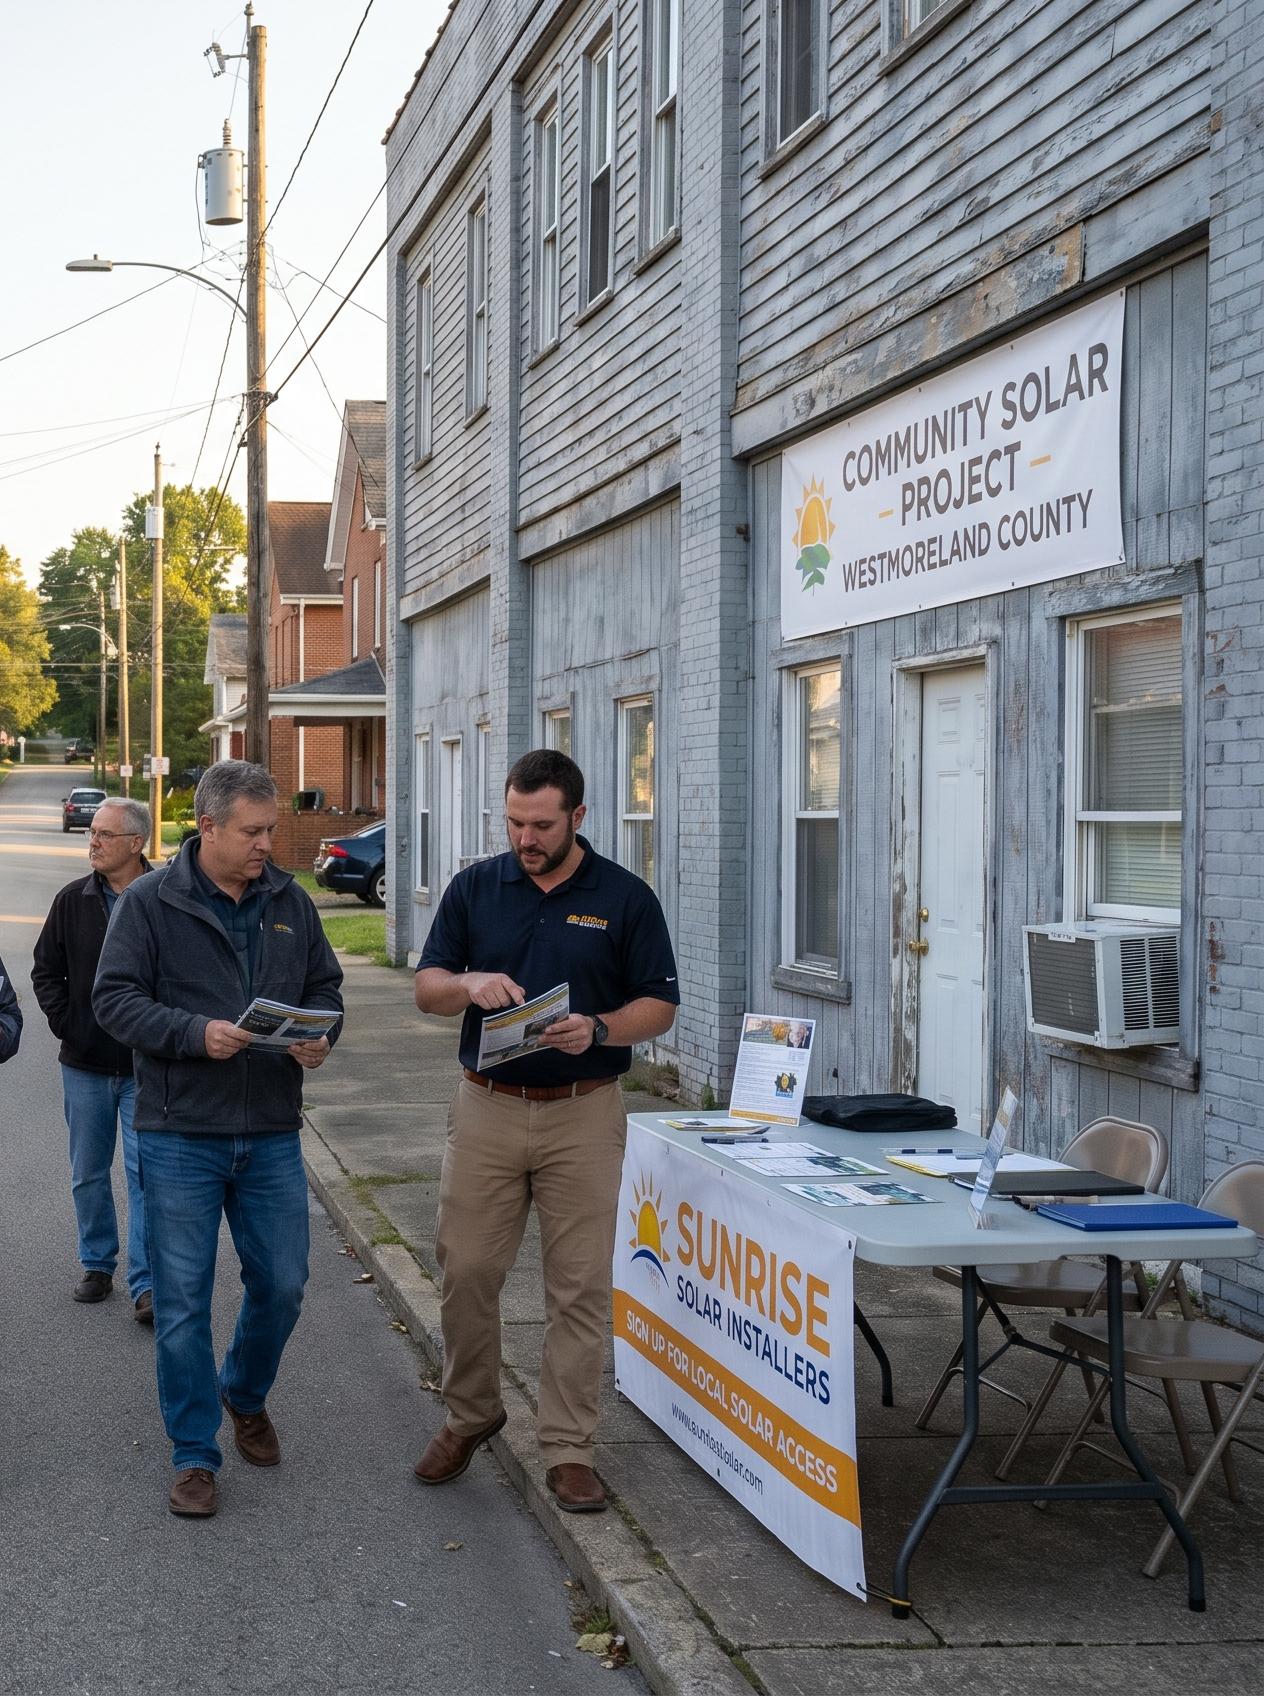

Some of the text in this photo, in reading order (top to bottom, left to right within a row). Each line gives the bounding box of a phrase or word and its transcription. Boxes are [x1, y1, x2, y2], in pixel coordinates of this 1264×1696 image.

[842, 342, 1109, 492] COMMUNITY SOLAR
[901, 441, 1021, 526] PROJECT
[842, 488, 1094, 593] WESTMORELAND COUNTY
[677, 1201, 831, 1358] SUNRISE
[677, 1275, 722, 1331] SOLAR
[727, 1307, 830, 1405] INSTALLERS
[627, 1310, 838, 1493] SIGN UP FOR LOCAL SOLAR ACCESS
